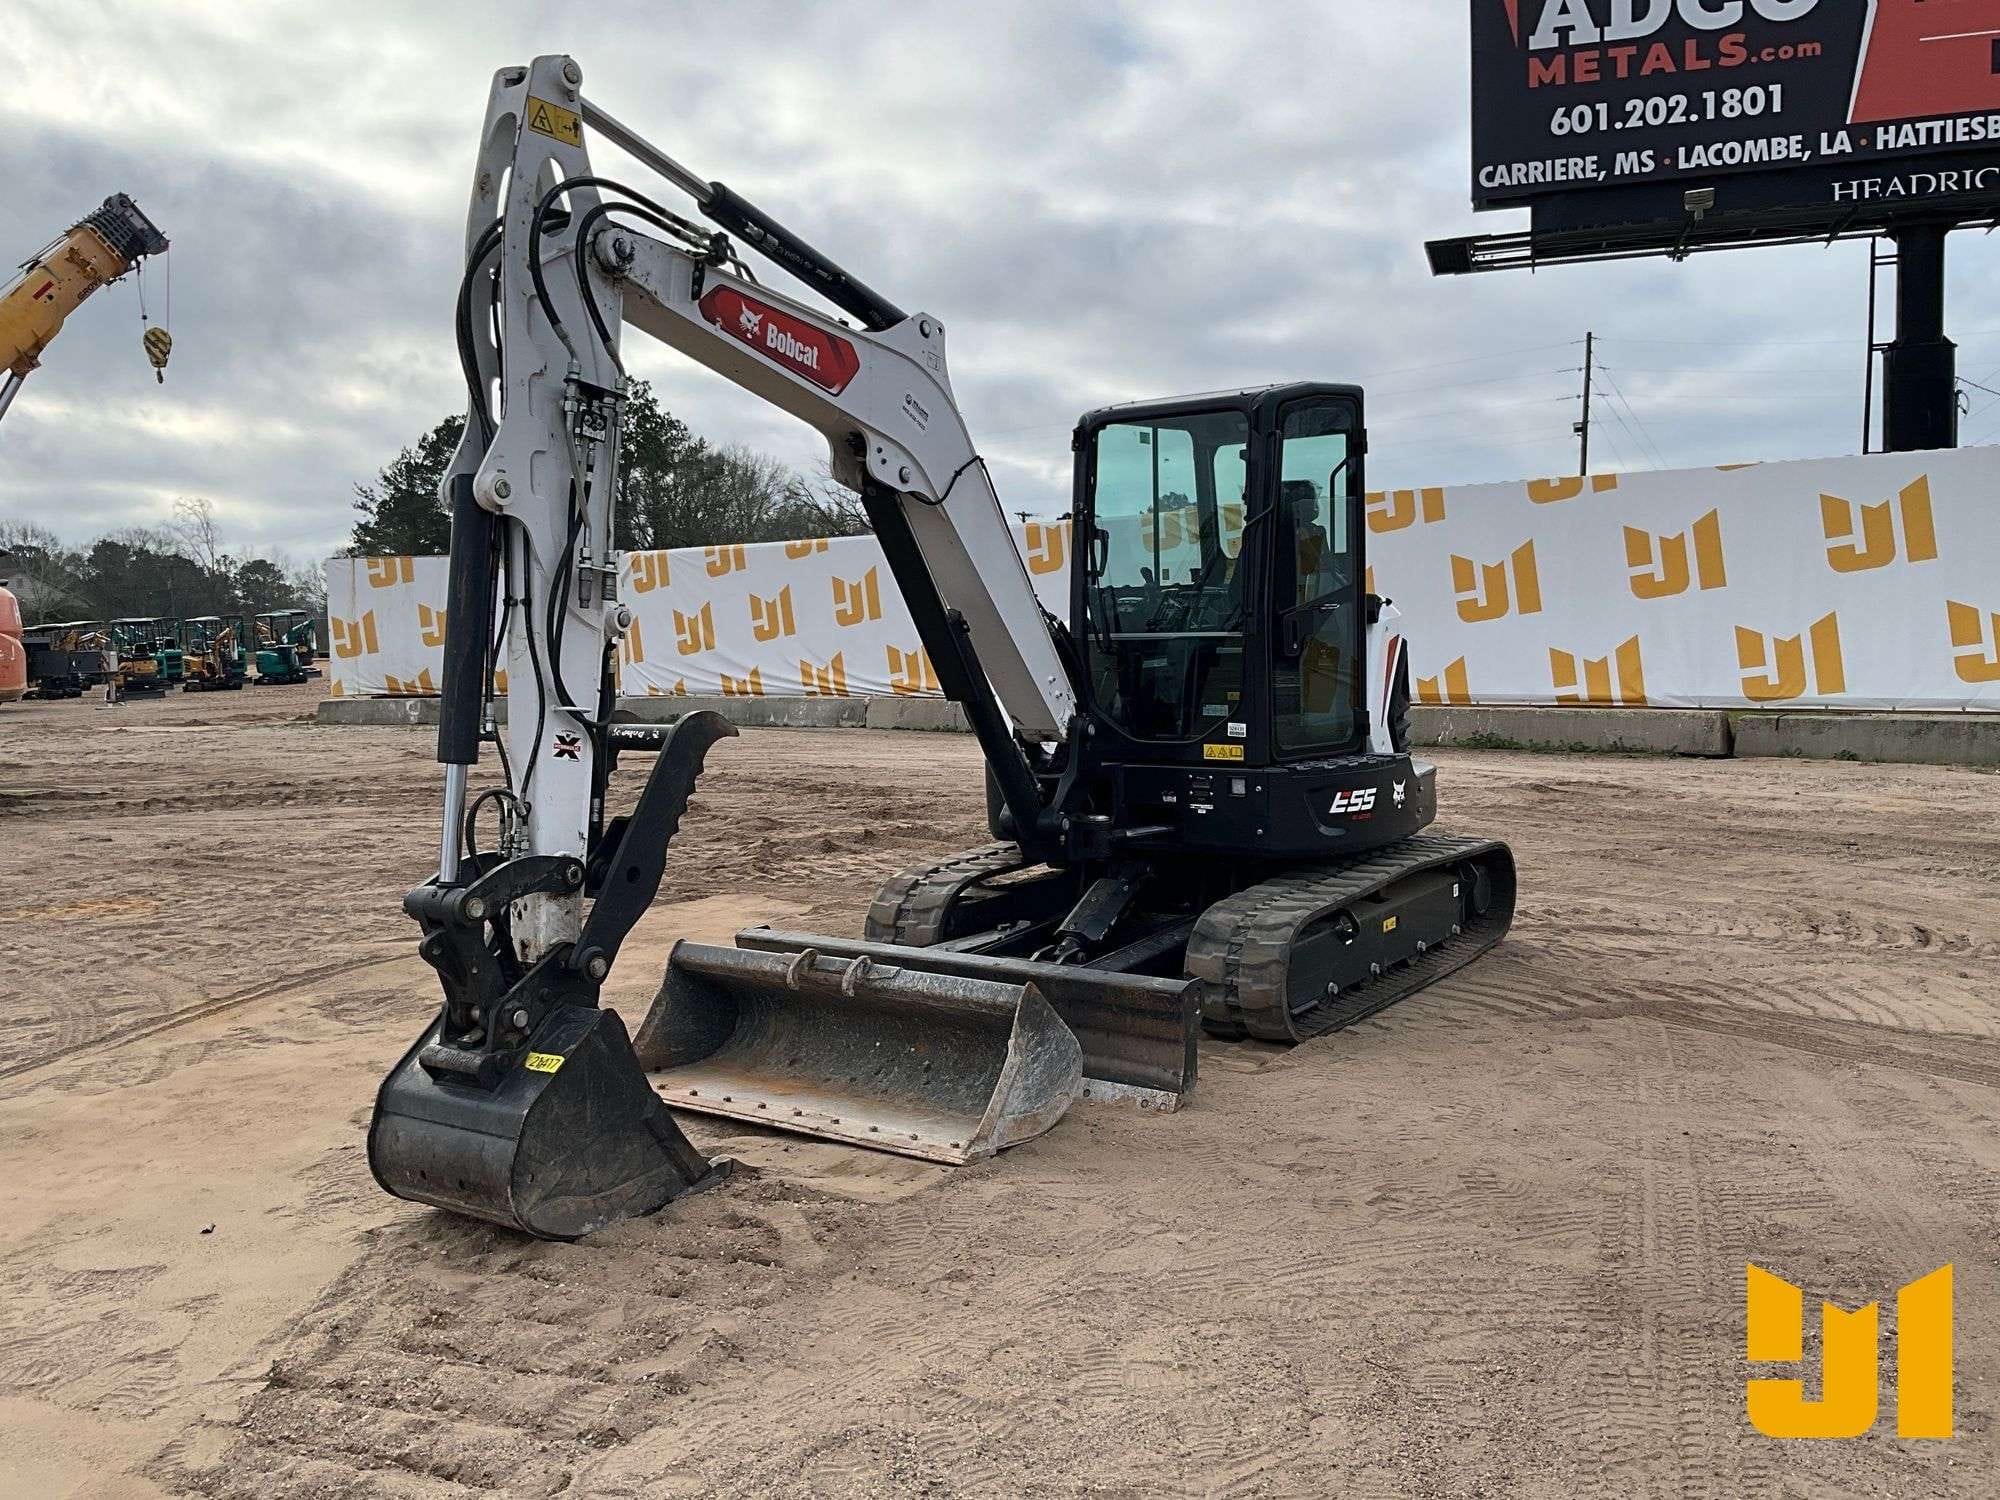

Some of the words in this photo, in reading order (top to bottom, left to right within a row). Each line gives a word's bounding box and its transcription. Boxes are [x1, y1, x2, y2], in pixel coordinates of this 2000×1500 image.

[1528, 0, 1820, 50] AD
[1528, 32, 1822, 89] METALS.com
[1550, 84, 1783, 136] 601.202.1801
[1478, 155, 1607, 188] CARRIERE,
[1613, 149, 1656, 175] MS
[1677, 134, 1812, 169] LACOMBE,
[1819, 130, 1853, 156] LA
[766, 322, 819, 370] Bobcat
[1328, 787, 1378, 814] E55
